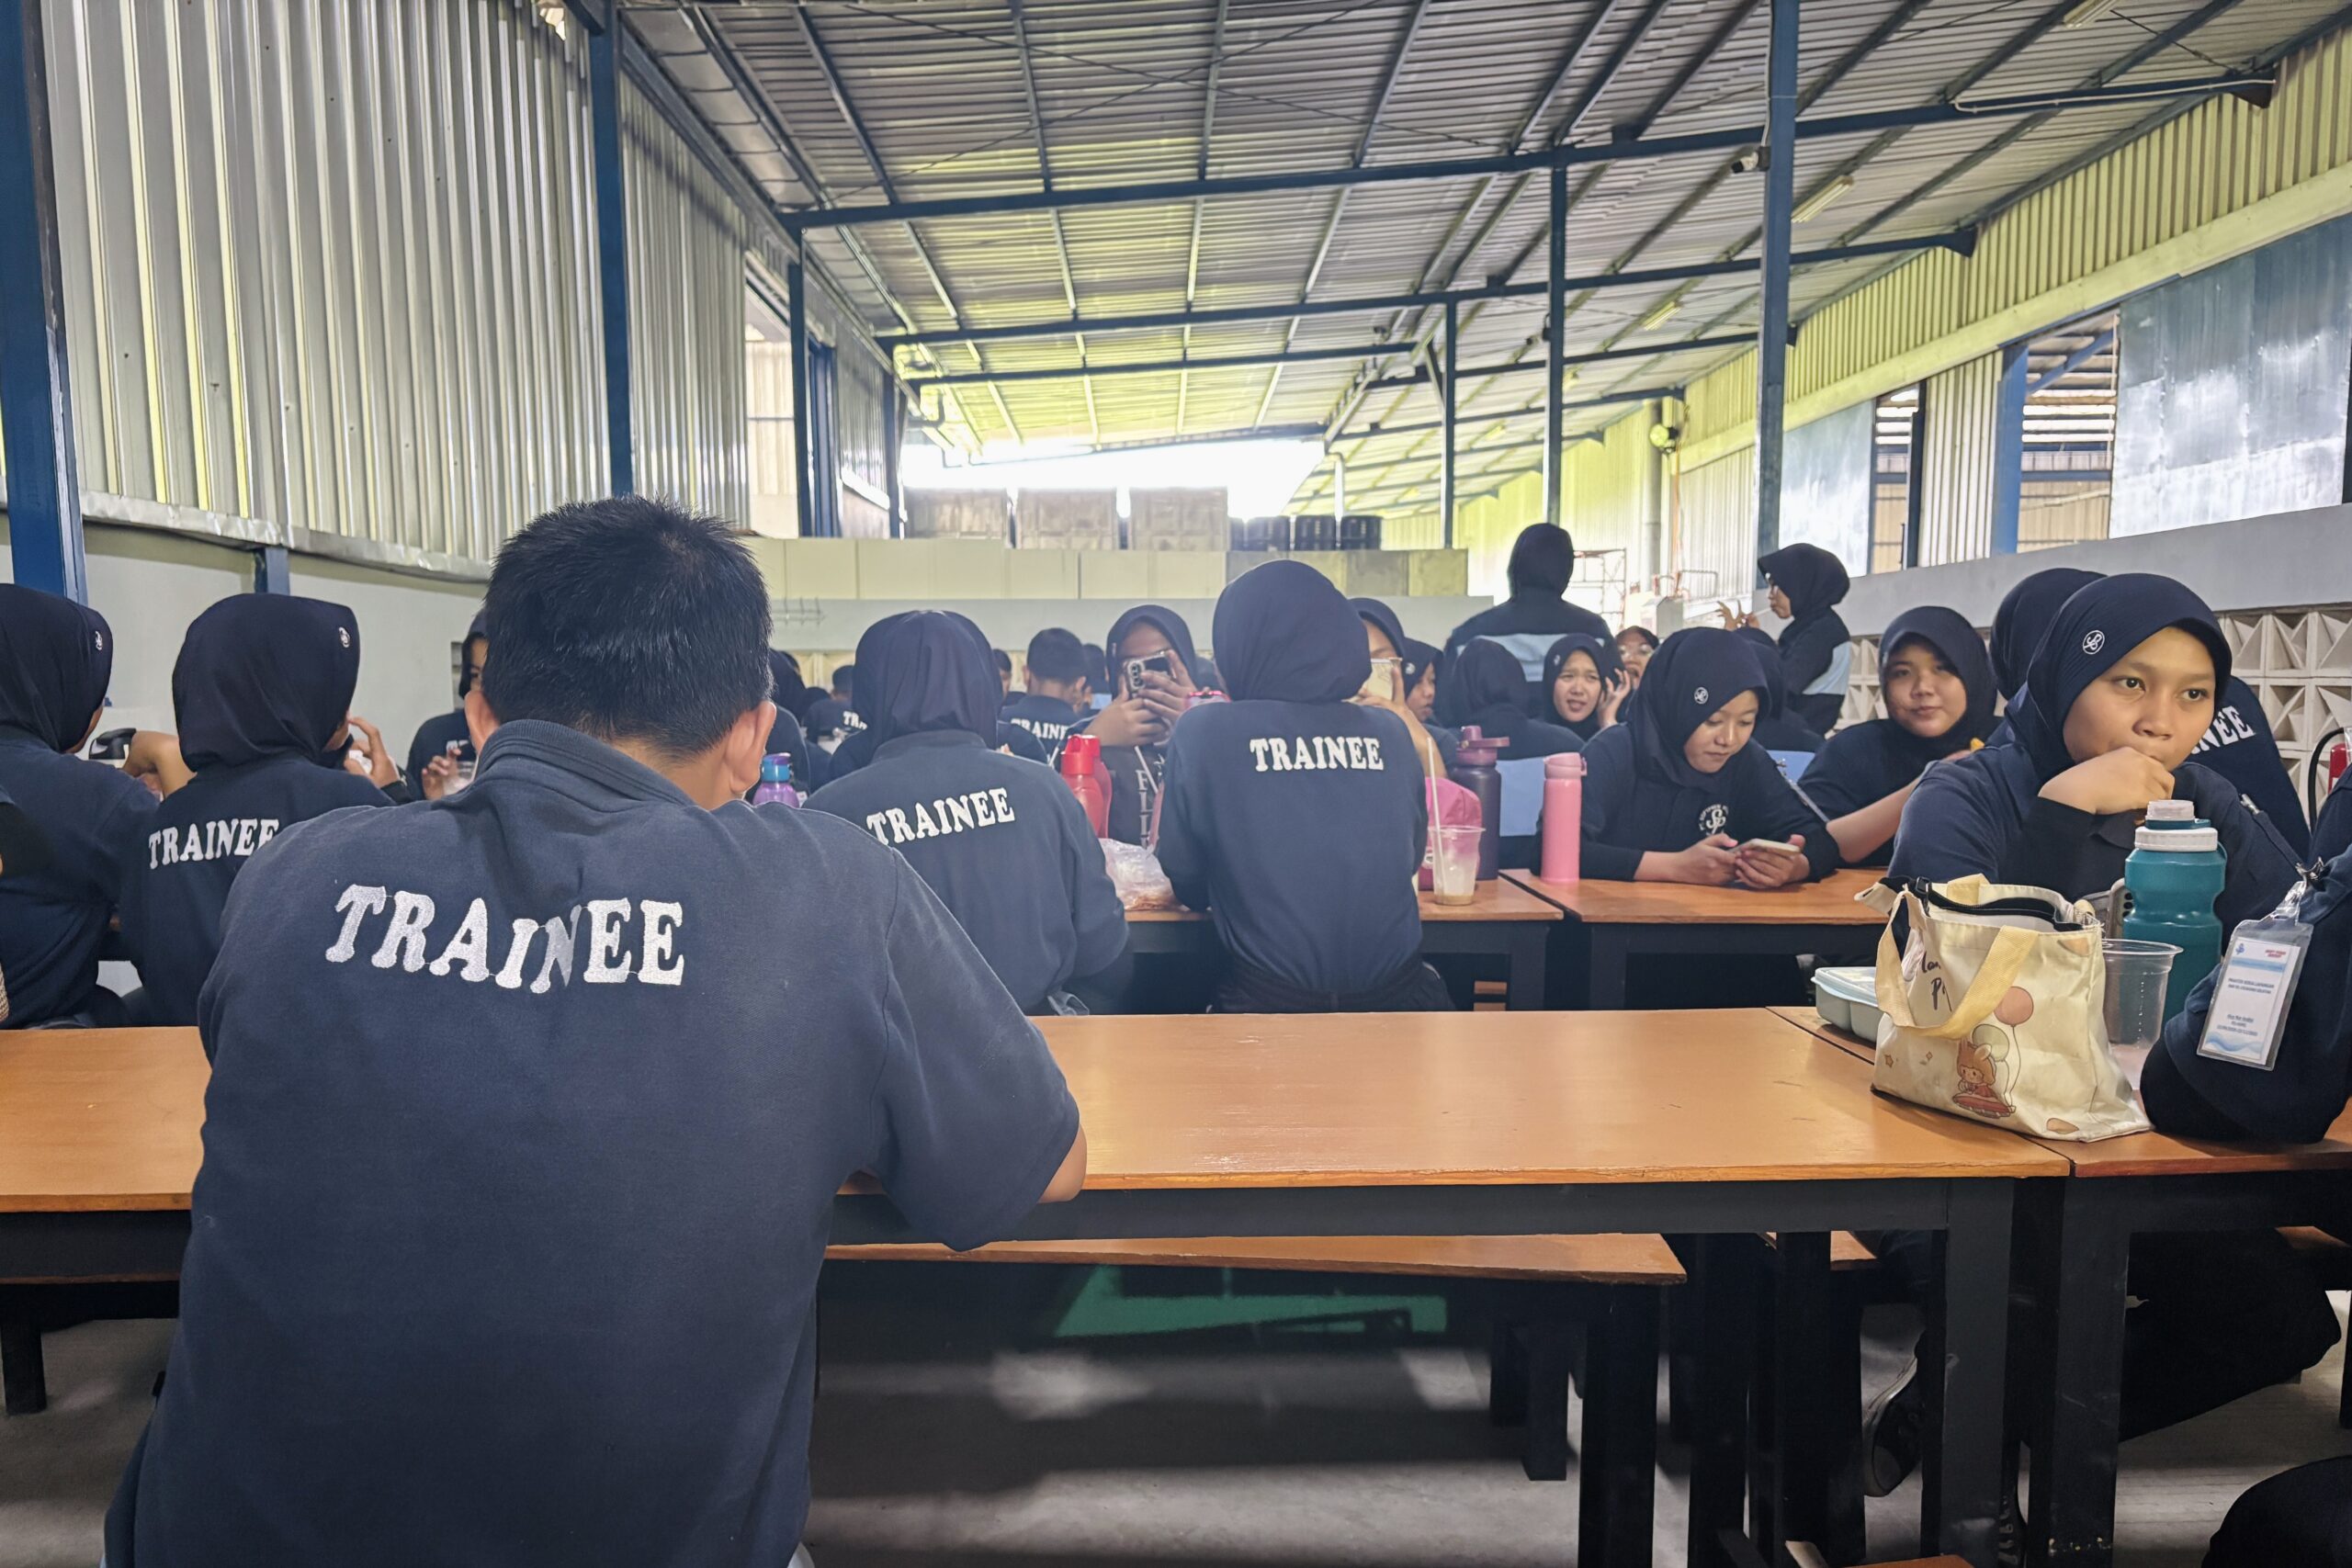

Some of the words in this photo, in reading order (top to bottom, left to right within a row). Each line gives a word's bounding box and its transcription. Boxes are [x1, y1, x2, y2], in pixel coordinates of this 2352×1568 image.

[1250, 736, 1384, 772] TRAINEE
[866, 787, 1015, 846] TRAINEE
[325, 884, 685, 994] TRAINEE
